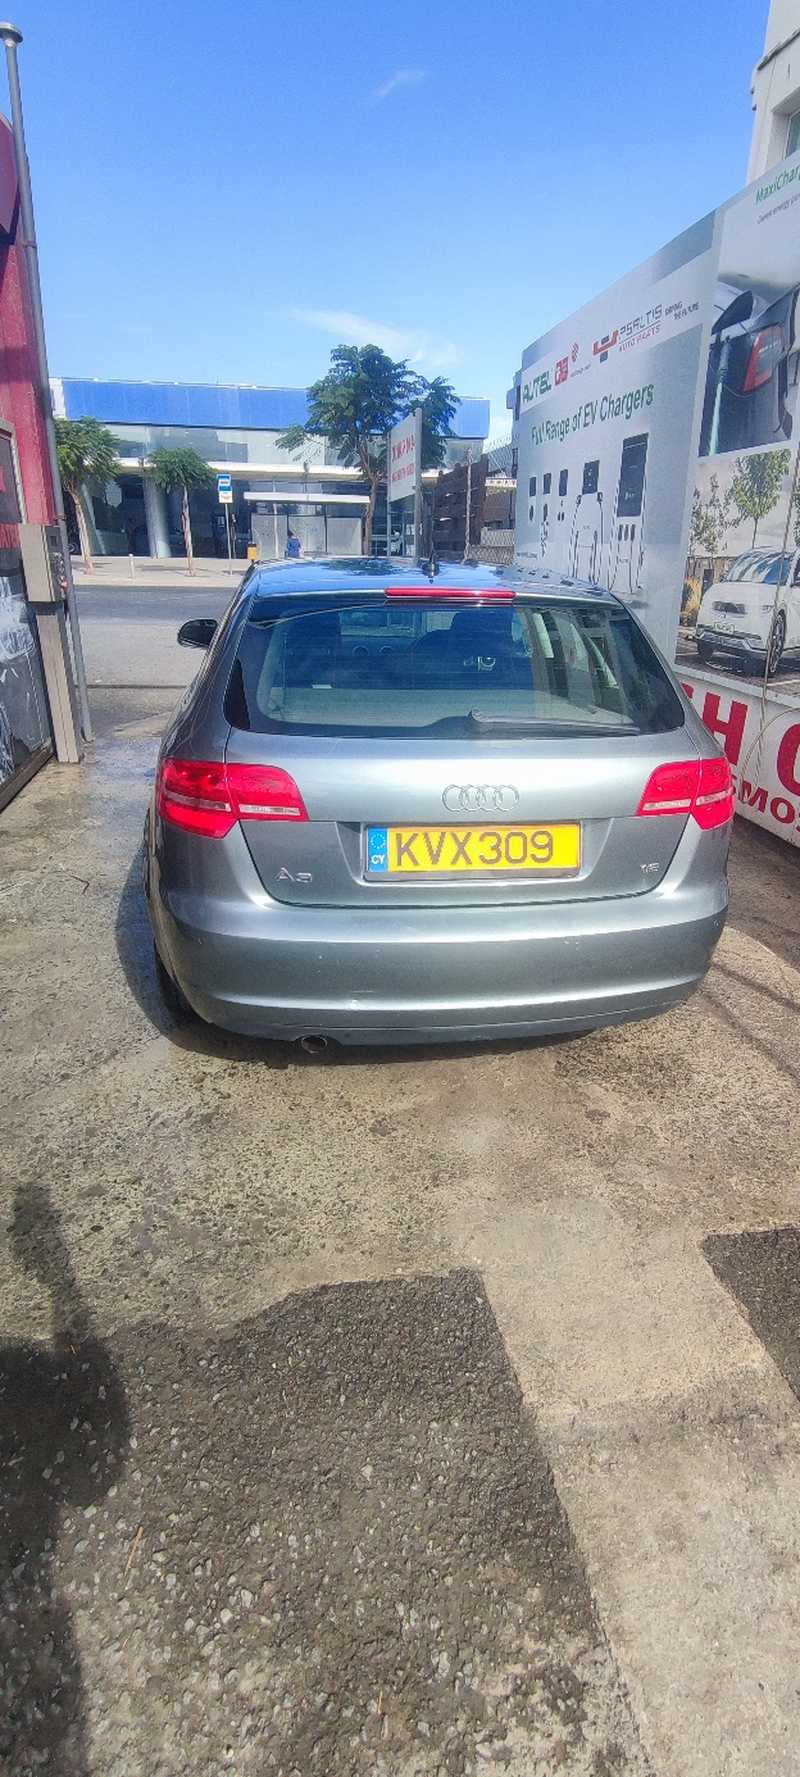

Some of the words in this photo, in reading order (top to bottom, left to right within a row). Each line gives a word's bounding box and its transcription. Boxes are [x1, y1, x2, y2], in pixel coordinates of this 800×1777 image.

[619, 304, 663, 337] PSALTIS
[619, 338, 636, 352] AUTO
[637, 325, 661, 345] PARTS
[522, 371, 552, 402] AUTEL
[531, 423, 545, 445] Full
[546, 418, 570, 442] Range
[572, 406, 583, 431] of
[583, 399, 599, 428] EV
[600, 384, 655, 421] Chargers
[370, 854, 385, 865] CY
[396, 830, 554, 867] KVX309
[274, 866, 312, 883] A3
